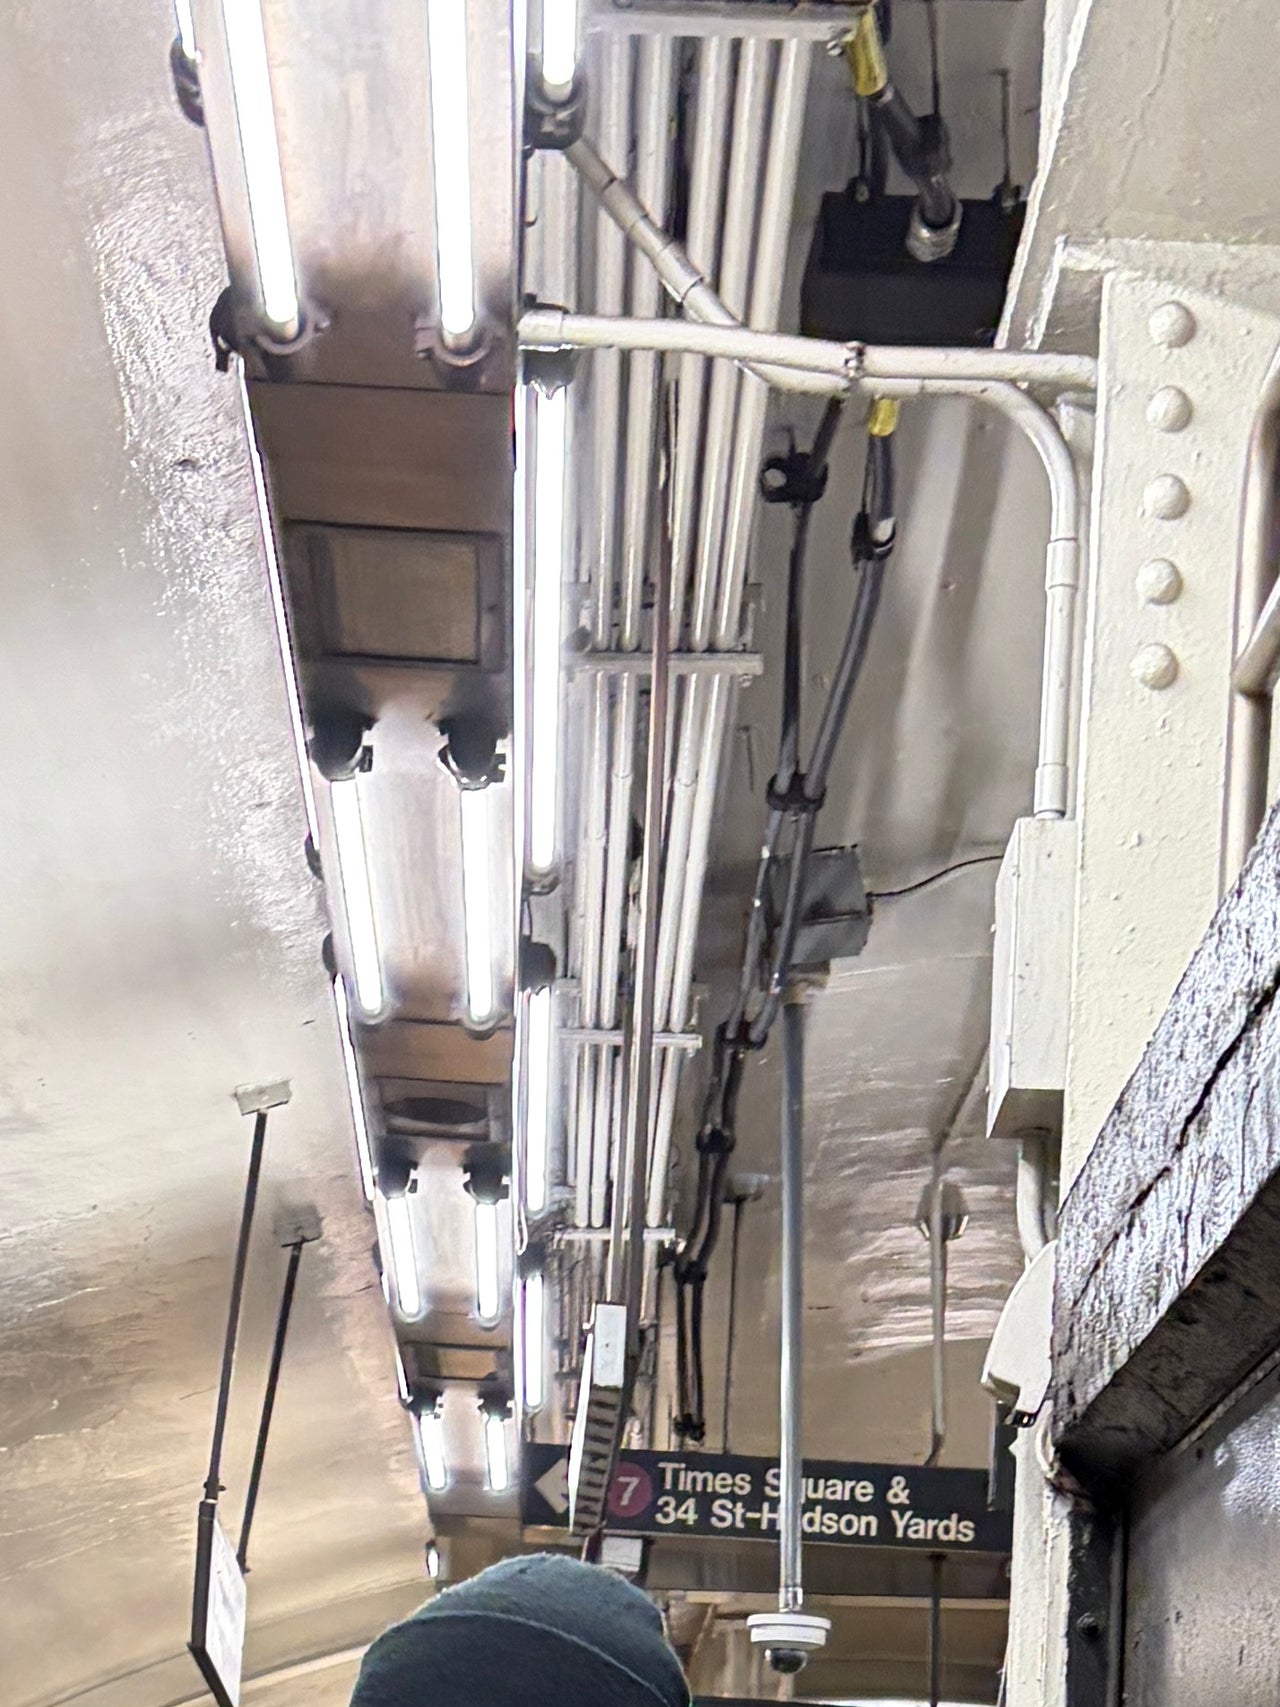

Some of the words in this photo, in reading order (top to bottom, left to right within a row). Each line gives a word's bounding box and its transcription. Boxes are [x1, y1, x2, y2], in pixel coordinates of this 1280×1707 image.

[617, 1476, 640, 1506] 7
[658, 1461, 752, 1496] Times
[763, 1466, 875, 1504] Suare
[886, 1475, 910, 1505] &
[655, 1495, 699, 1525] 34
[710, 1498, 879, 1537] St-Hdson
[891, 1508, 975, 1542] Yards
